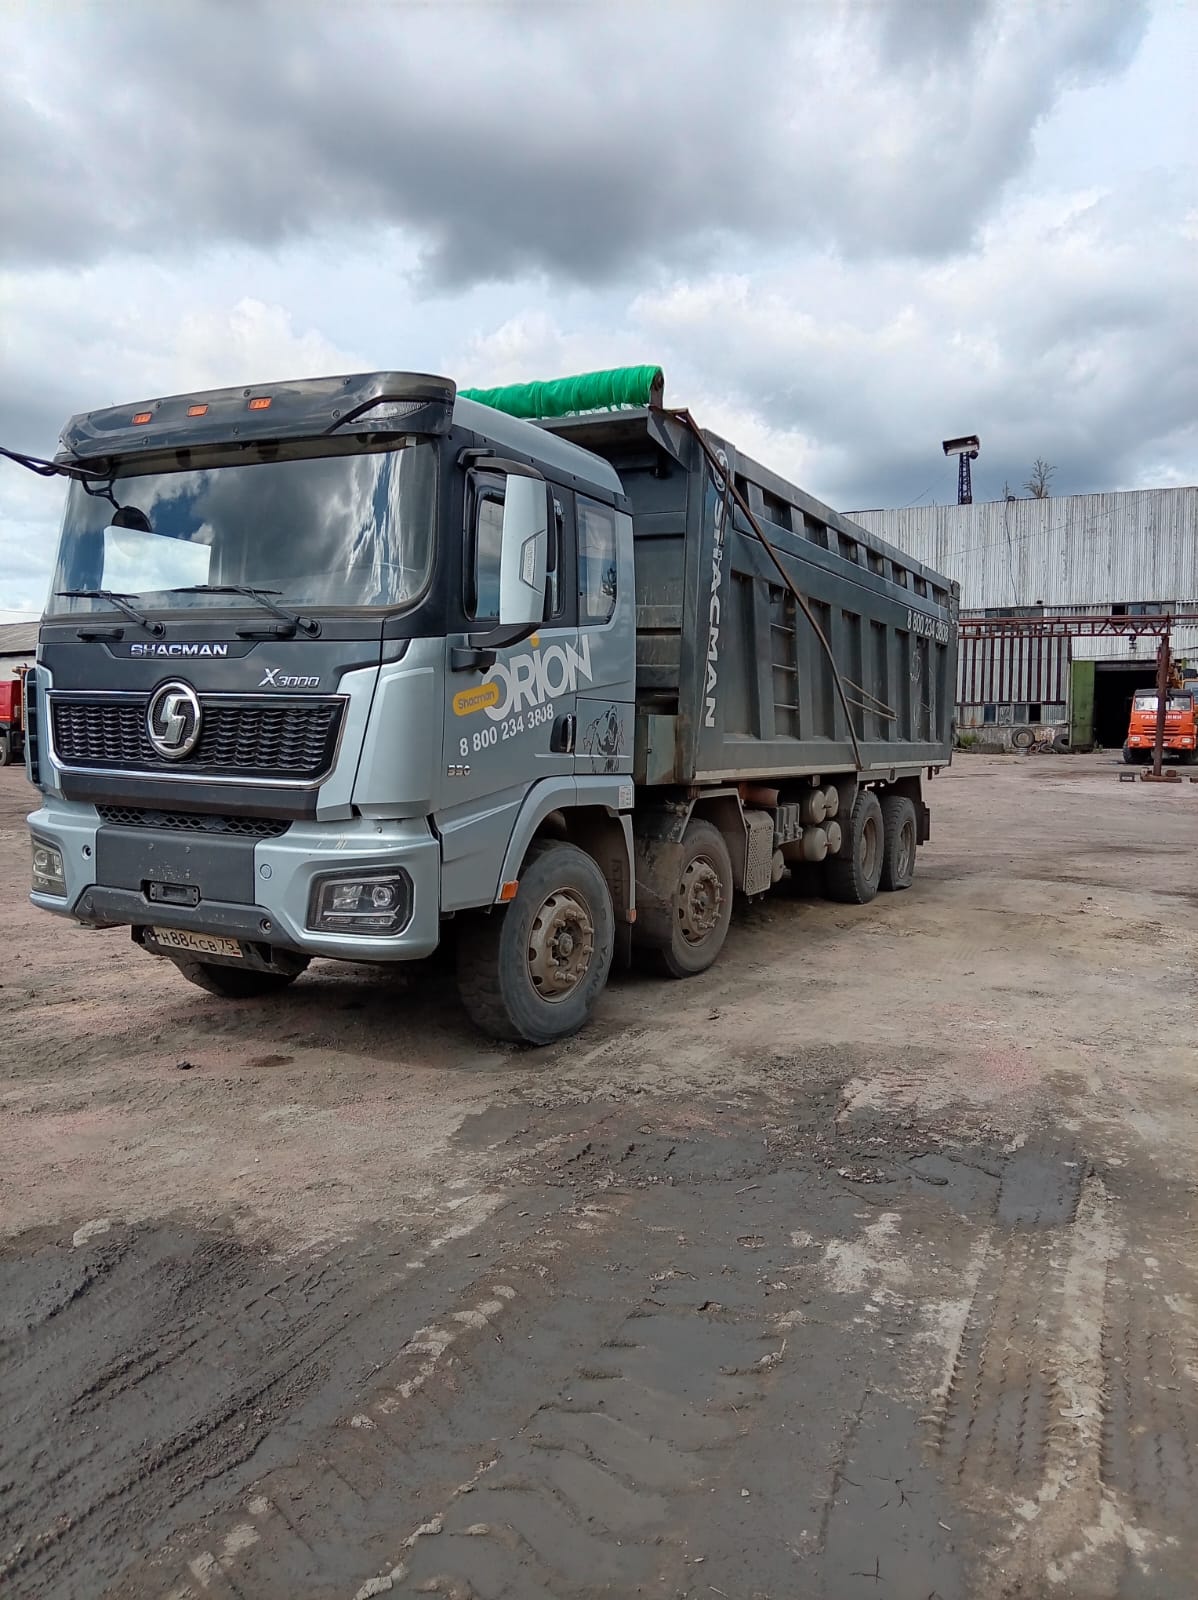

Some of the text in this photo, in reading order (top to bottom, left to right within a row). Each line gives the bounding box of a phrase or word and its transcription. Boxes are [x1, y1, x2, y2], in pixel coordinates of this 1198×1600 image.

[907, 609, 949, 643] 8 800 234 3808
[130, 644, 228, 656] SHACMAN
[257, 668, 321, 688] X3000
[457, 689, 496, 710] Shacman
[459, 703, 554, 756] 8 800 234 3808
